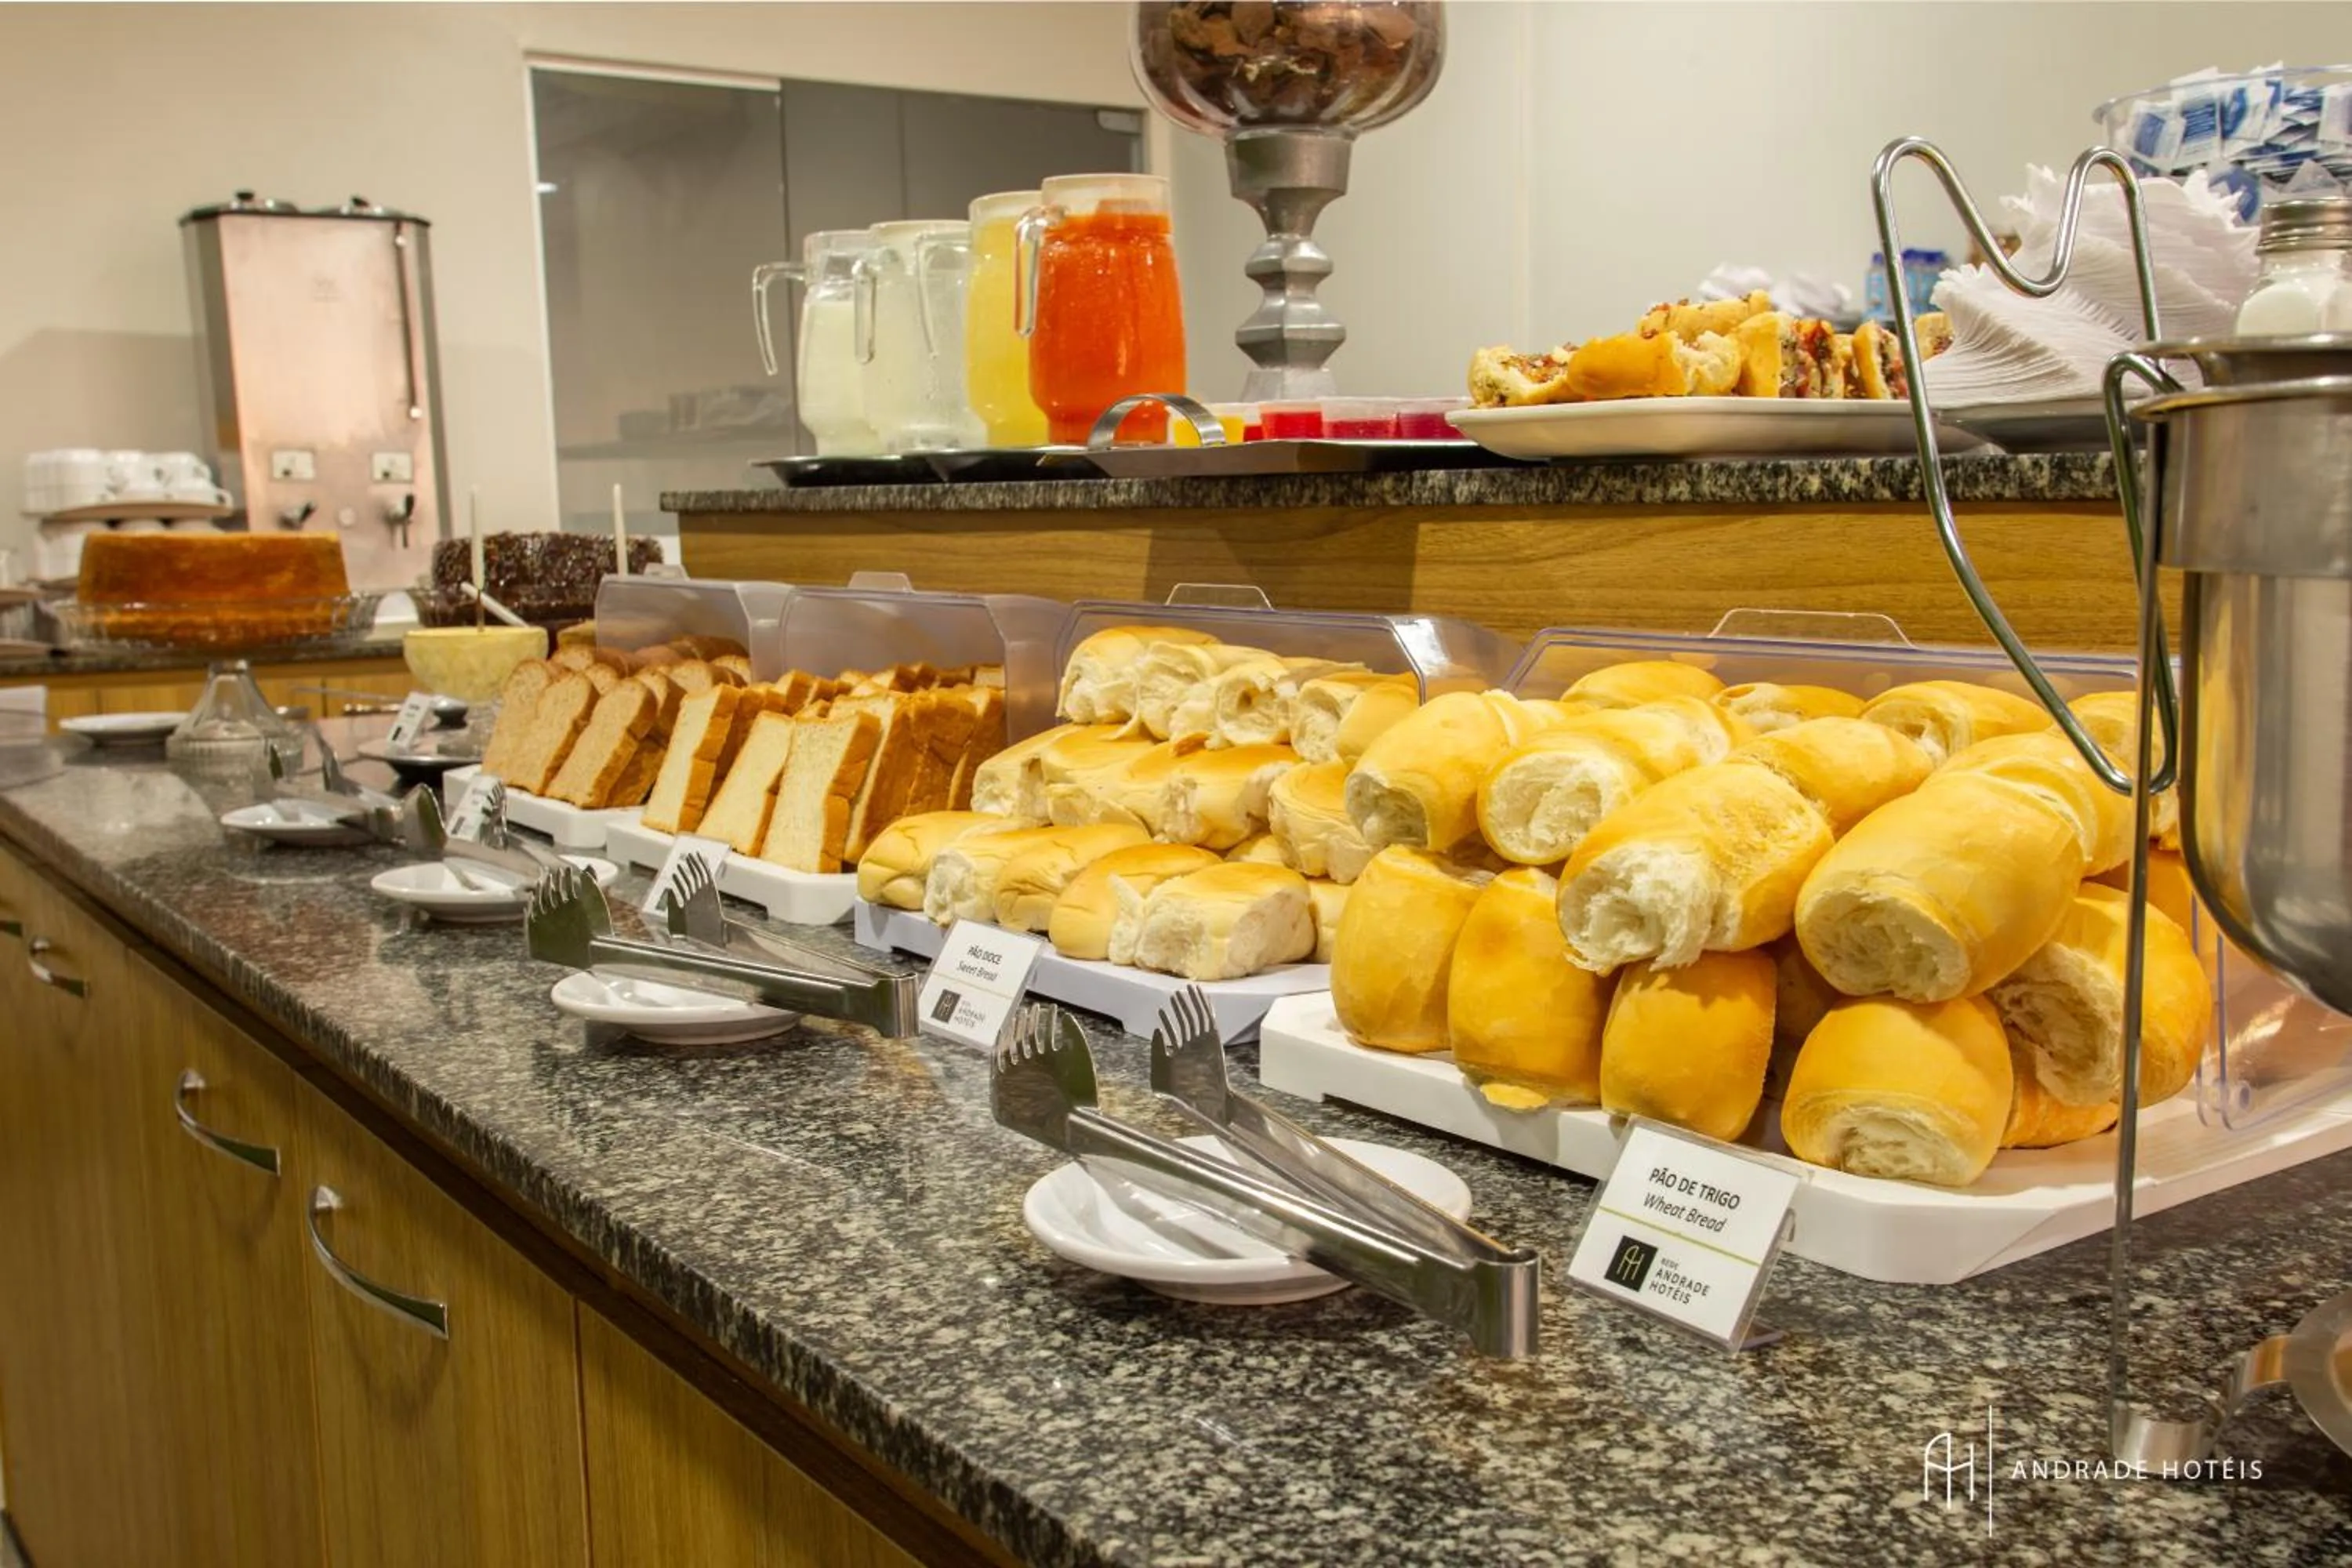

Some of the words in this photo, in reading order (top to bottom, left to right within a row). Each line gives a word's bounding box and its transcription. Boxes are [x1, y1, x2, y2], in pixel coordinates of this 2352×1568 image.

[1650, 1167, 1677, 1188] PÃO
[1678, 1178, 1698, 1195] DE
[1699, 1184, 1740, 1210] TRIGO
[1643, 1192, 1686, 1219] Wheat
[1685, 1208, 1727, 1232] Bread
[1649, 1280, 1692, 1305] HOTÉIS
[1655, 1269, 1710, 1296] ANDRADE
